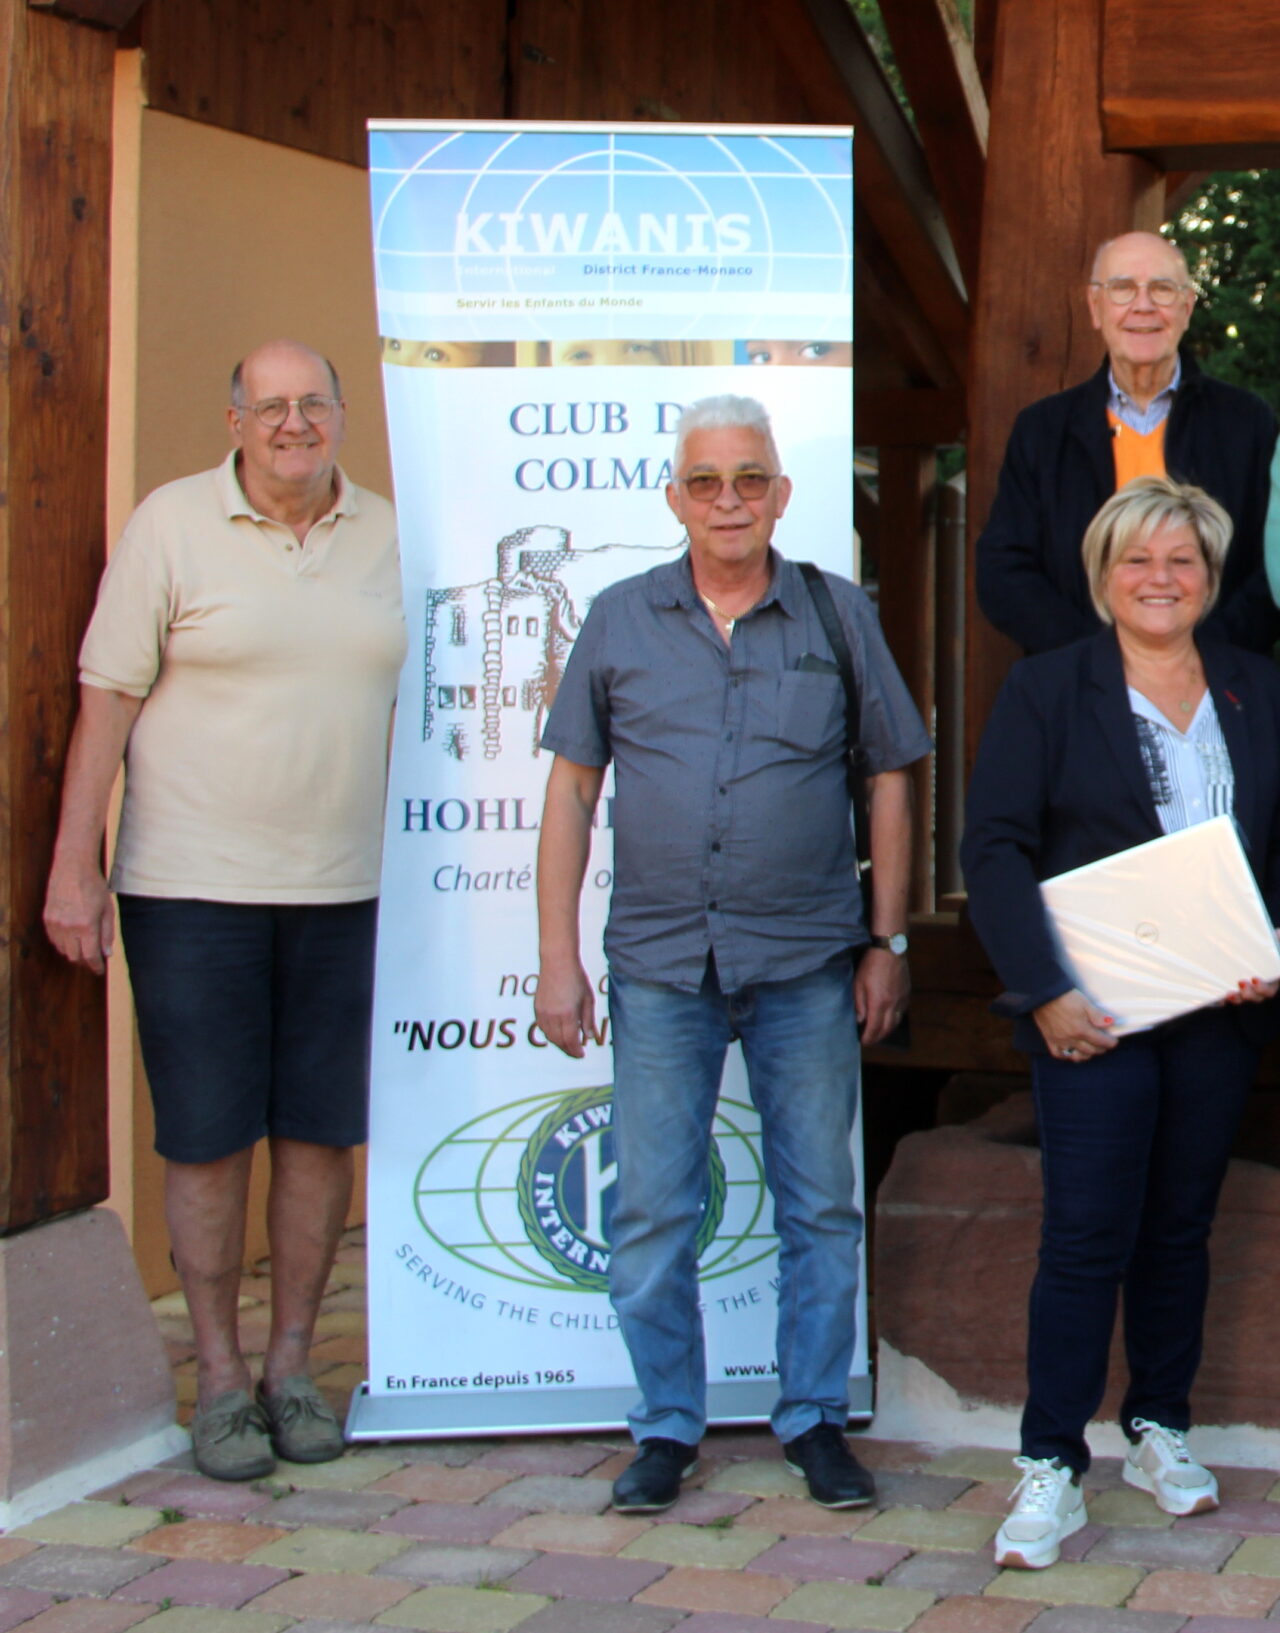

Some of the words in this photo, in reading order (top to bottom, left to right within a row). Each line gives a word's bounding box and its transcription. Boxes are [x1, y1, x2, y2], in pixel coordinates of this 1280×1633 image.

[456, 212, 753, 254] KIWANIS
[583, 264, 637, 275] District
[642, 264, 753, 276] France-Monaco
[456, 298, 497, 309] Servir
[501, 298, 521, 309] les
[525, 298, 575, 310] Enfants
[578, 297, 595, 308] du
[600, 297, 643, 308] Monde
[510, 402, 630, 436] CLUB
[654, 402, 684, 435] D
[515, 457, 675, 492] COLMA
[433, 864, 532, 891] Charté
[396, 1243, 487, 1310] SERVING
[497, 1300, 539, 1325] THE
[550, 1311, 621, 1330] CHILD
[720, 1287, 762, 1313] THE
[386, 1375, 407, 1389] En
[412, 1374, 466, 1389] France
[473, 1371, 529, 1389] depuis
[535, 1370, 575, 1384] 1965
